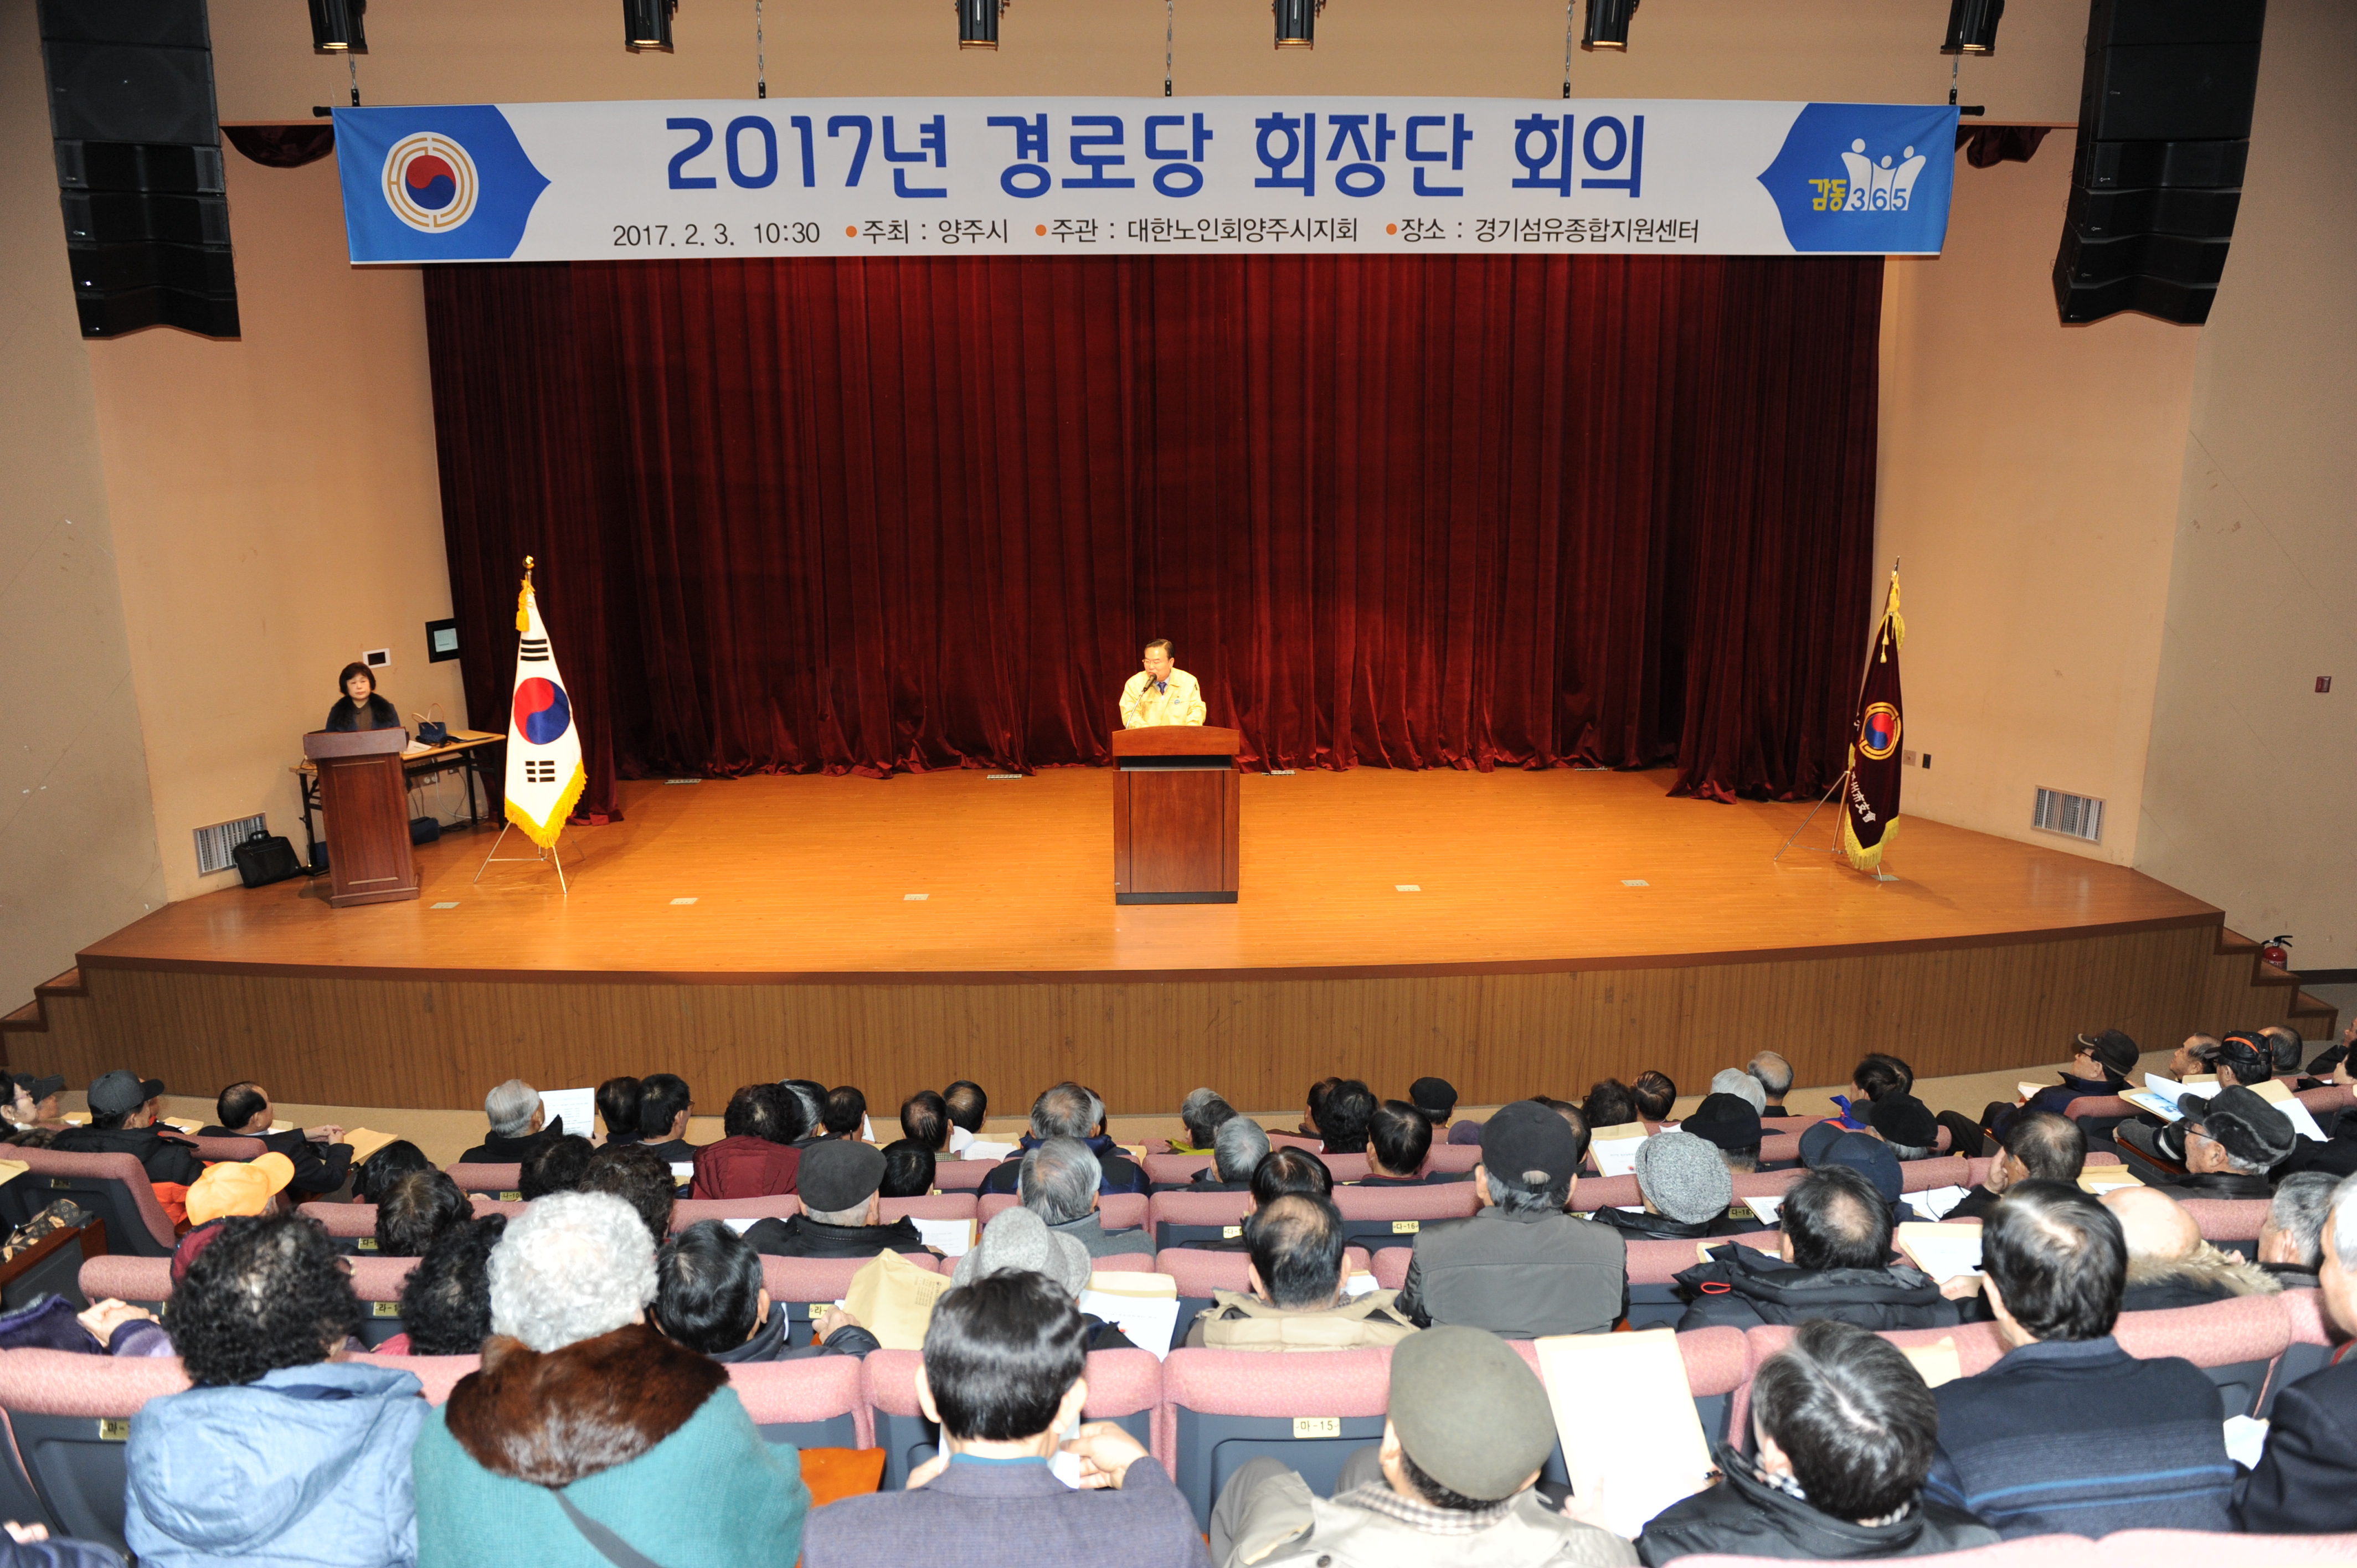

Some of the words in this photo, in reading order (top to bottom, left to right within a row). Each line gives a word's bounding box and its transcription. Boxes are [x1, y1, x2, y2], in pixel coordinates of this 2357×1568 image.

[666, 114, 948, 198] 2017년
[987, 112, 1213, 199] 경로당
[1254, 112, 1473, 198] 회장단
[1512, 113, 1644, 198] 회의
[1809, 178, 1847, 212] 감동
[1850, 188, 1907, 210] 365
[613, 225, 676, 247] 2017.
[685, 224, 706, 247] 2.
[714, 223, 735, 246] 3.
[754, 223, 821, 244] 10:30
[863, 220, 909, 245] 주최
[939, 220, 1008, 245] 양주시
[1052, 219, 1099, 244] 주관
[1128, 218, 1357, 243] 대한노인회양주시지회
[1401, 218, 1446, 243] 장소
[1475, 218, 1699, 244] 경기섬유종합지원센터
[1300, 1420, 1334, 1432] 마-15
